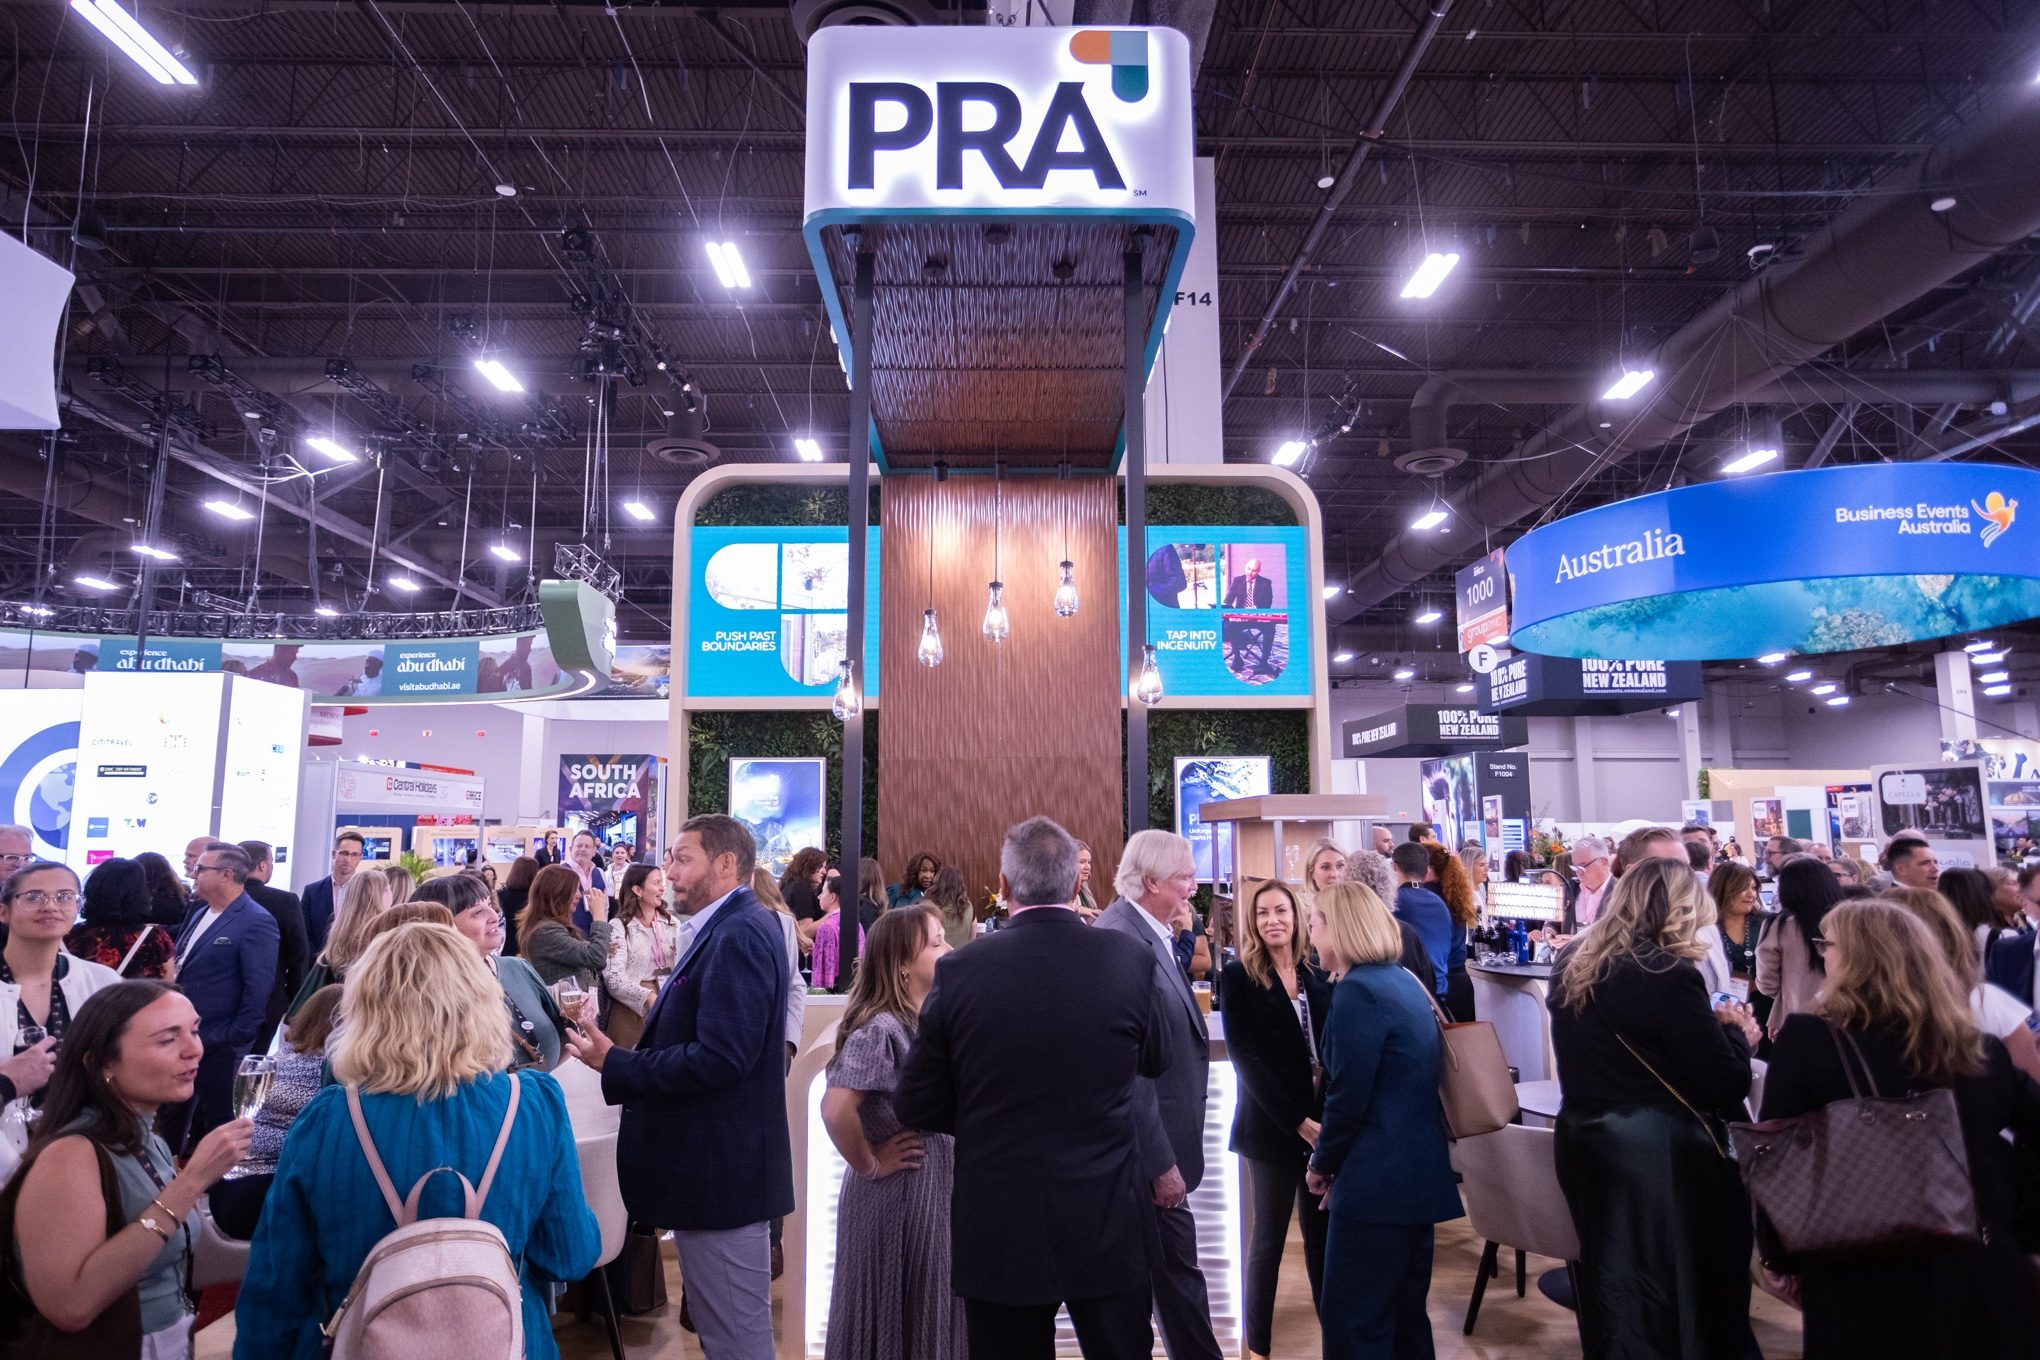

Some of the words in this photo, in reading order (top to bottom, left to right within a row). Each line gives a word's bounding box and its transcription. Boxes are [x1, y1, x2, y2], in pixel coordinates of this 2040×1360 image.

[848, 81, 1127, 190] PRA
[1133, 189, 1147, 197] SM
[1174, 292, 1212, 306] F14
[1835, 505, 1913, 522] Business
[1916, 503, 1969, 519] Events
[1898, 519, 1971, 534] Australia
[1555, 528, 1686, 584] Australia
[1467, 576, 1493, 607] 1000
[716, 631, 746, 641] PUSH
[750, 631, 776, 641] PAST
[1166, 630, 1187, 640] TAP
[1190, 630, 1216, 640] INTO
[702, 641, 776, 652] BOUNDARIES
[1157, 641, 1216, 650] INGENUITY
[397, 660, 424, 672] abu
[1478, 652, 1488, 667] F
[1582, 658, 1623, 672] 100%
[1625, 660, 1665, 671] PURE
[1509, 660, 1526, 681] PURE
[399, 681, 461, 691] visitabudhabi.ae
[1583, 672, 1609, 687] NEW
[1611, 672, 1666, 687] ZEALAND
[1503, 679, 1527, 698] ZEALAND
[1437, 710, 1468, 724] 100%
[1470, 710, 1499, 724] PURE
[1379, 722, 1396, 740] ZEALAND
[1439, 725, 1458, 736] NEW
[1460, 725, 1499, 736] ZEALAND
[571, 764, 637, 780] SOUTH
[393, 779, 414, 792] Central
[415, 780, 437, 793] Holidays
[569, 783, 641, 798] AFRICA
